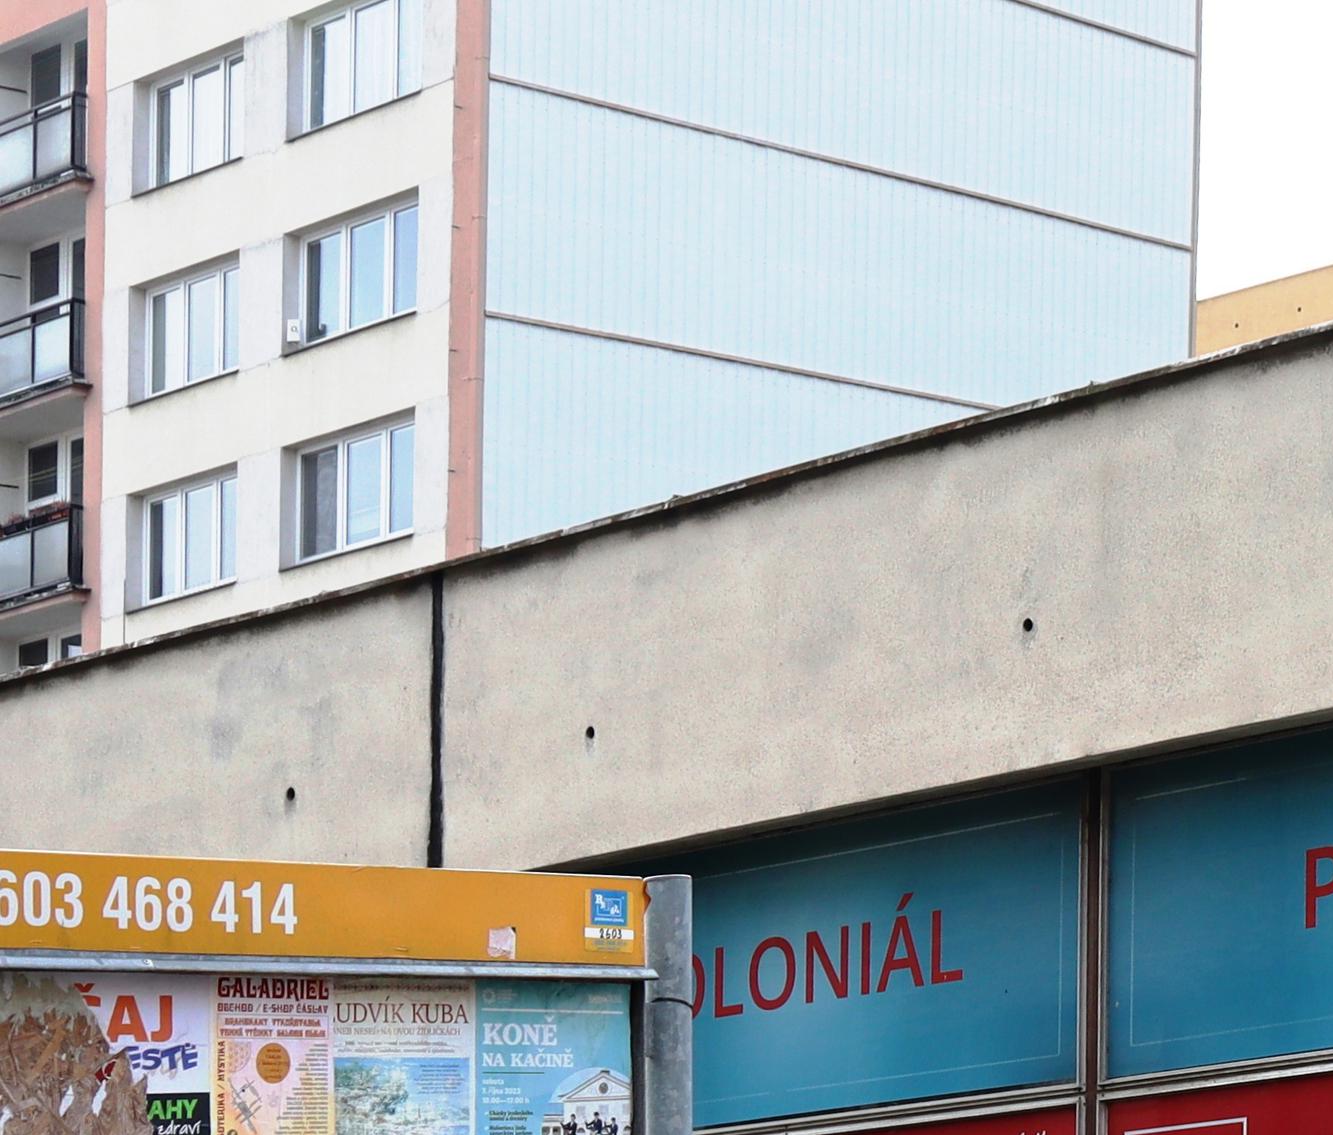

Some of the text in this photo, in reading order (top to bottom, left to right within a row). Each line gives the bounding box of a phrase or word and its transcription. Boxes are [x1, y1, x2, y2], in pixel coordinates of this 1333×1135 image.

[0, 870, 298, 935] 603 468 414
[692, 893, 963, 1021] LONIÁL
[217, 977, 329, 1001] GALADRIEL
[217, 1003, 253, 1012] OBCHOD
[263, 1004, 294, 1013] E-SHOP
[333, 995, 469, 1024] UDVÍK KUBA
[482, 1015, 557, 1046] KONĚ
[217, 1041, 225, 1081] MYSTIKA
[482, 1048, 574, 1067] NA KAČINĚ
[157, 1120, 201, 1135] zdraví
